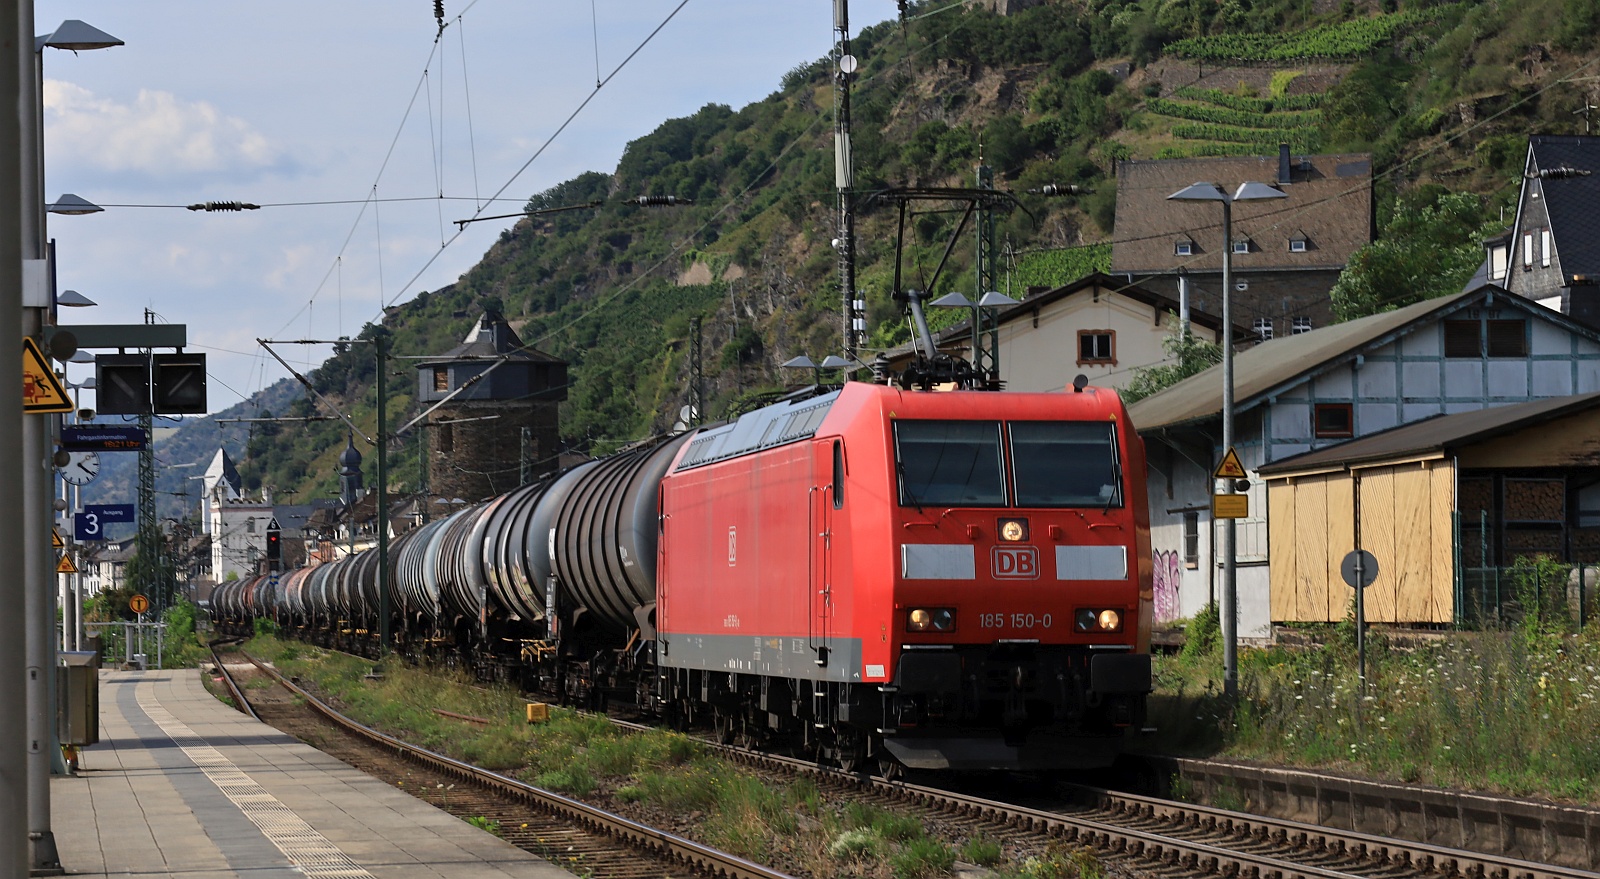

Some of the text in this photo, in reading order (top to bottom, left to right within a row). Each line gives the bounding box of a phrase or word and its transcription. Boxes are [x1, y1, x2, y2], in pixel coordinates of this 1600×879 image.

[126, 440, 141, 448] Uhr
[85, 513, 99, 535] 3
[997, 551, 1034, 573] DB
[979, 613, 1052, 628] 185 150-0
